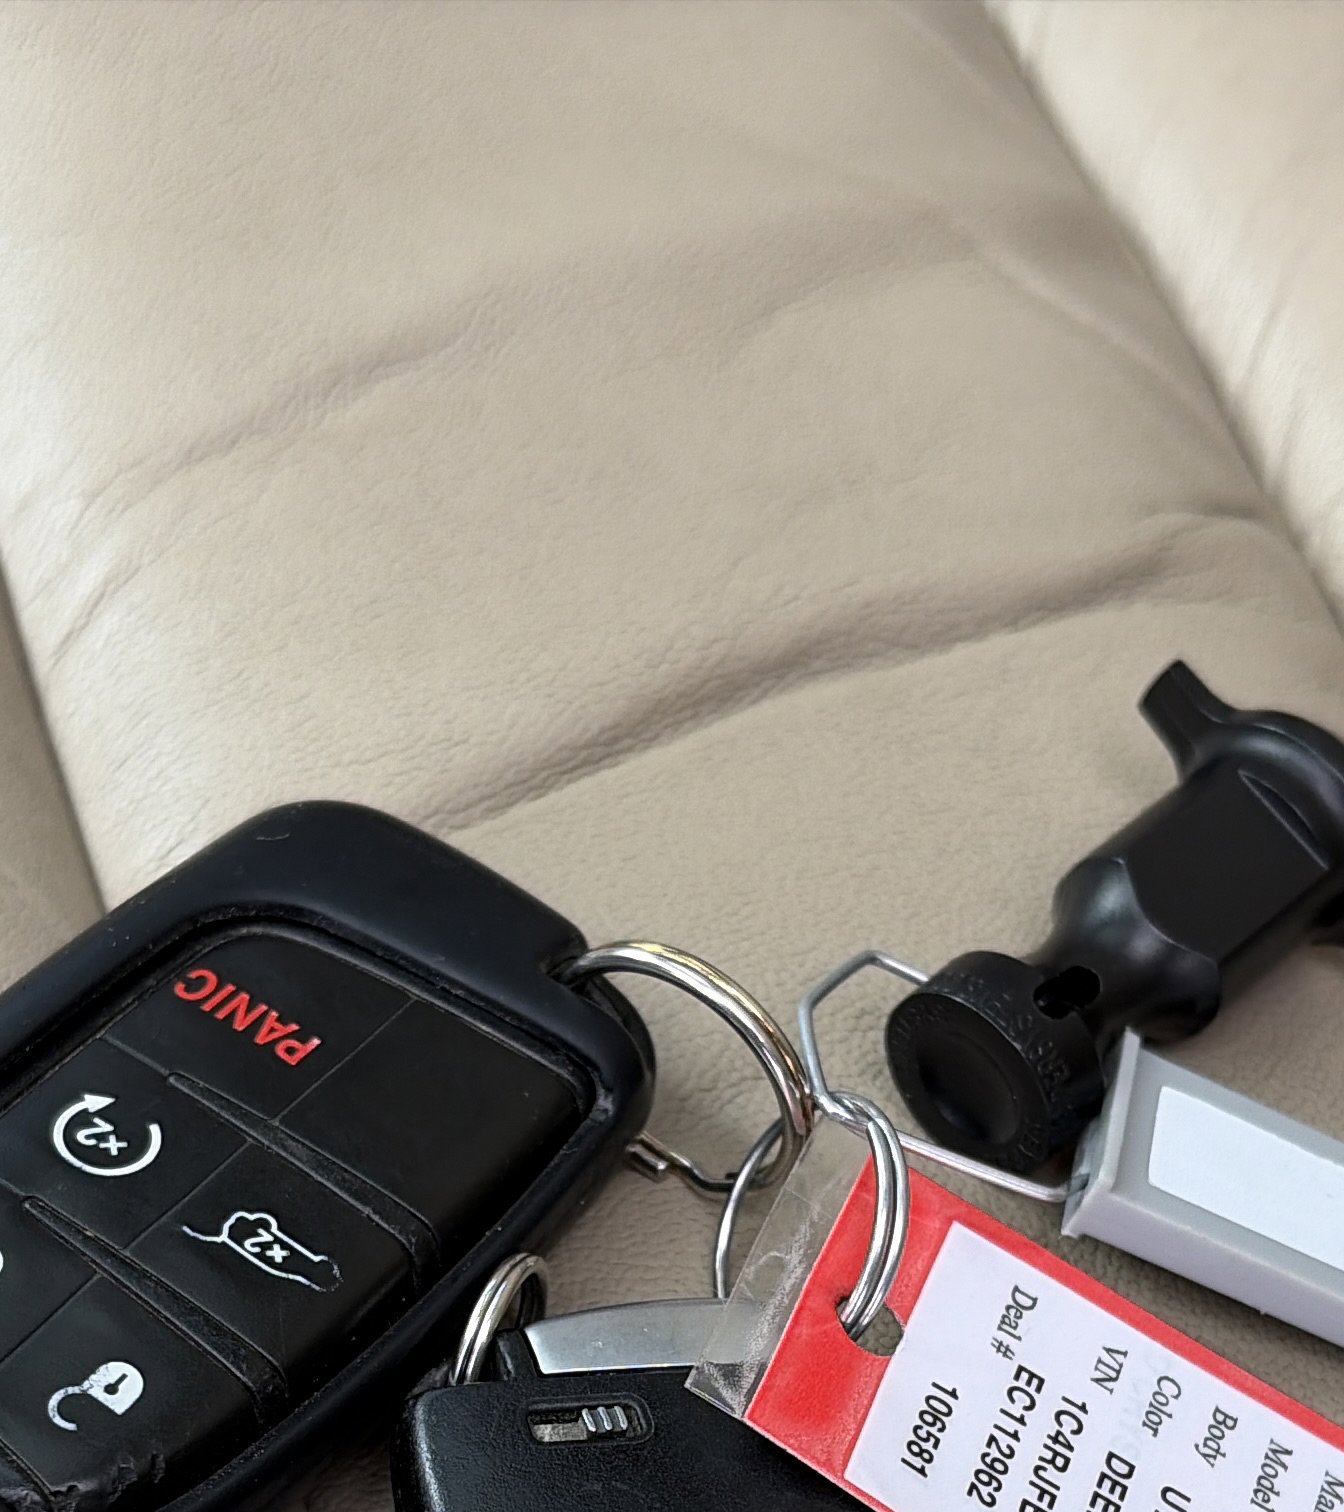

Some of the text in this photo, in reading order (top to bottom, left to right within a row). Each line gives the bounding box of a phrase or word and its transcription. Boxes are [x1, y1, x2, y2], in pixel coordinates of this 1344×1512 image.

[172, 968, 322, 1067] PANIC
[990, 1284, 1039, 1361] Deal #
[1090, 1345, 1129, 1395] VIN
[1142, 1374, 1182, 1438] Color
[900, 1381, 959, 1479] 106581
[966, 1364, 1046, 1508] EC112962
[1194, 1405, 1239, 1468] Body
